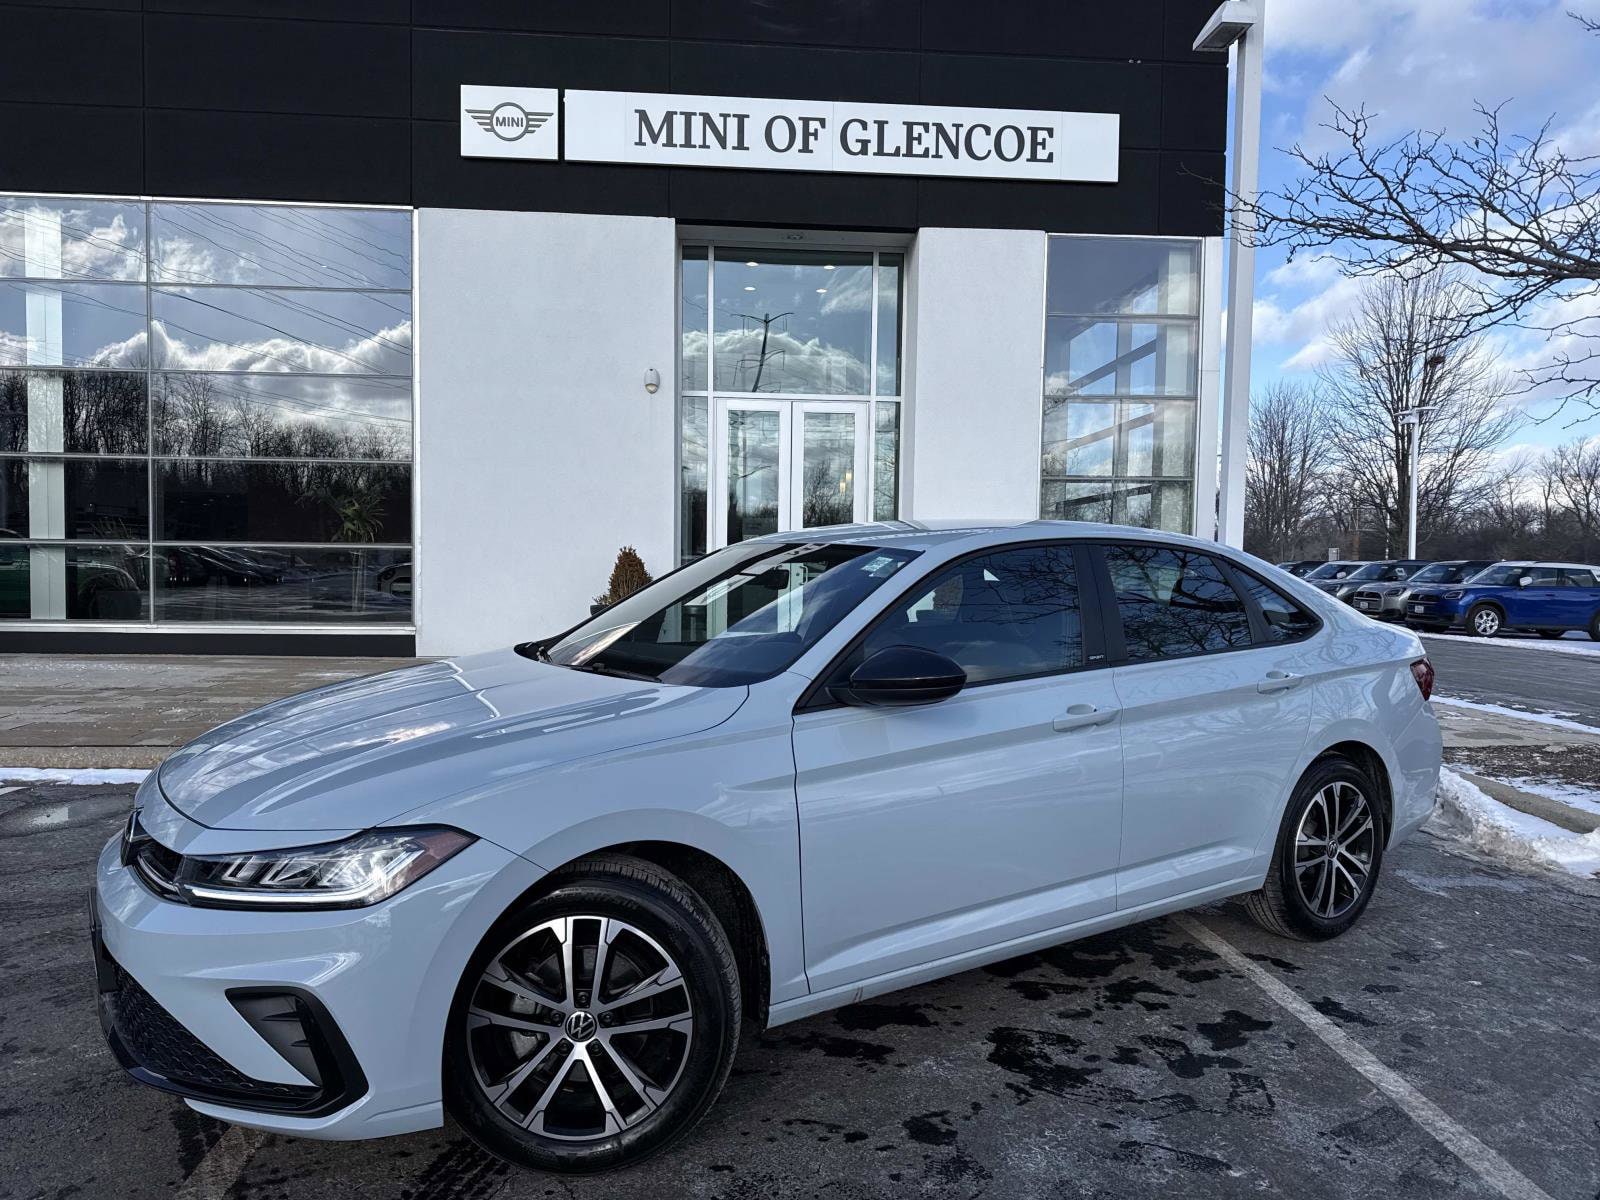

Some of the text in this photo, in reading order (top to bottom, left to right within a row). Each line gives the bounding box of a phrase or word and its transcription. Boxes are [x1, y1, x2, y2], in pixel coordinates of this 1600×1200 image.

[495, 116, 524, 128] MINI
[634, 108, 1054, 164] MINI OF GLENCOE
